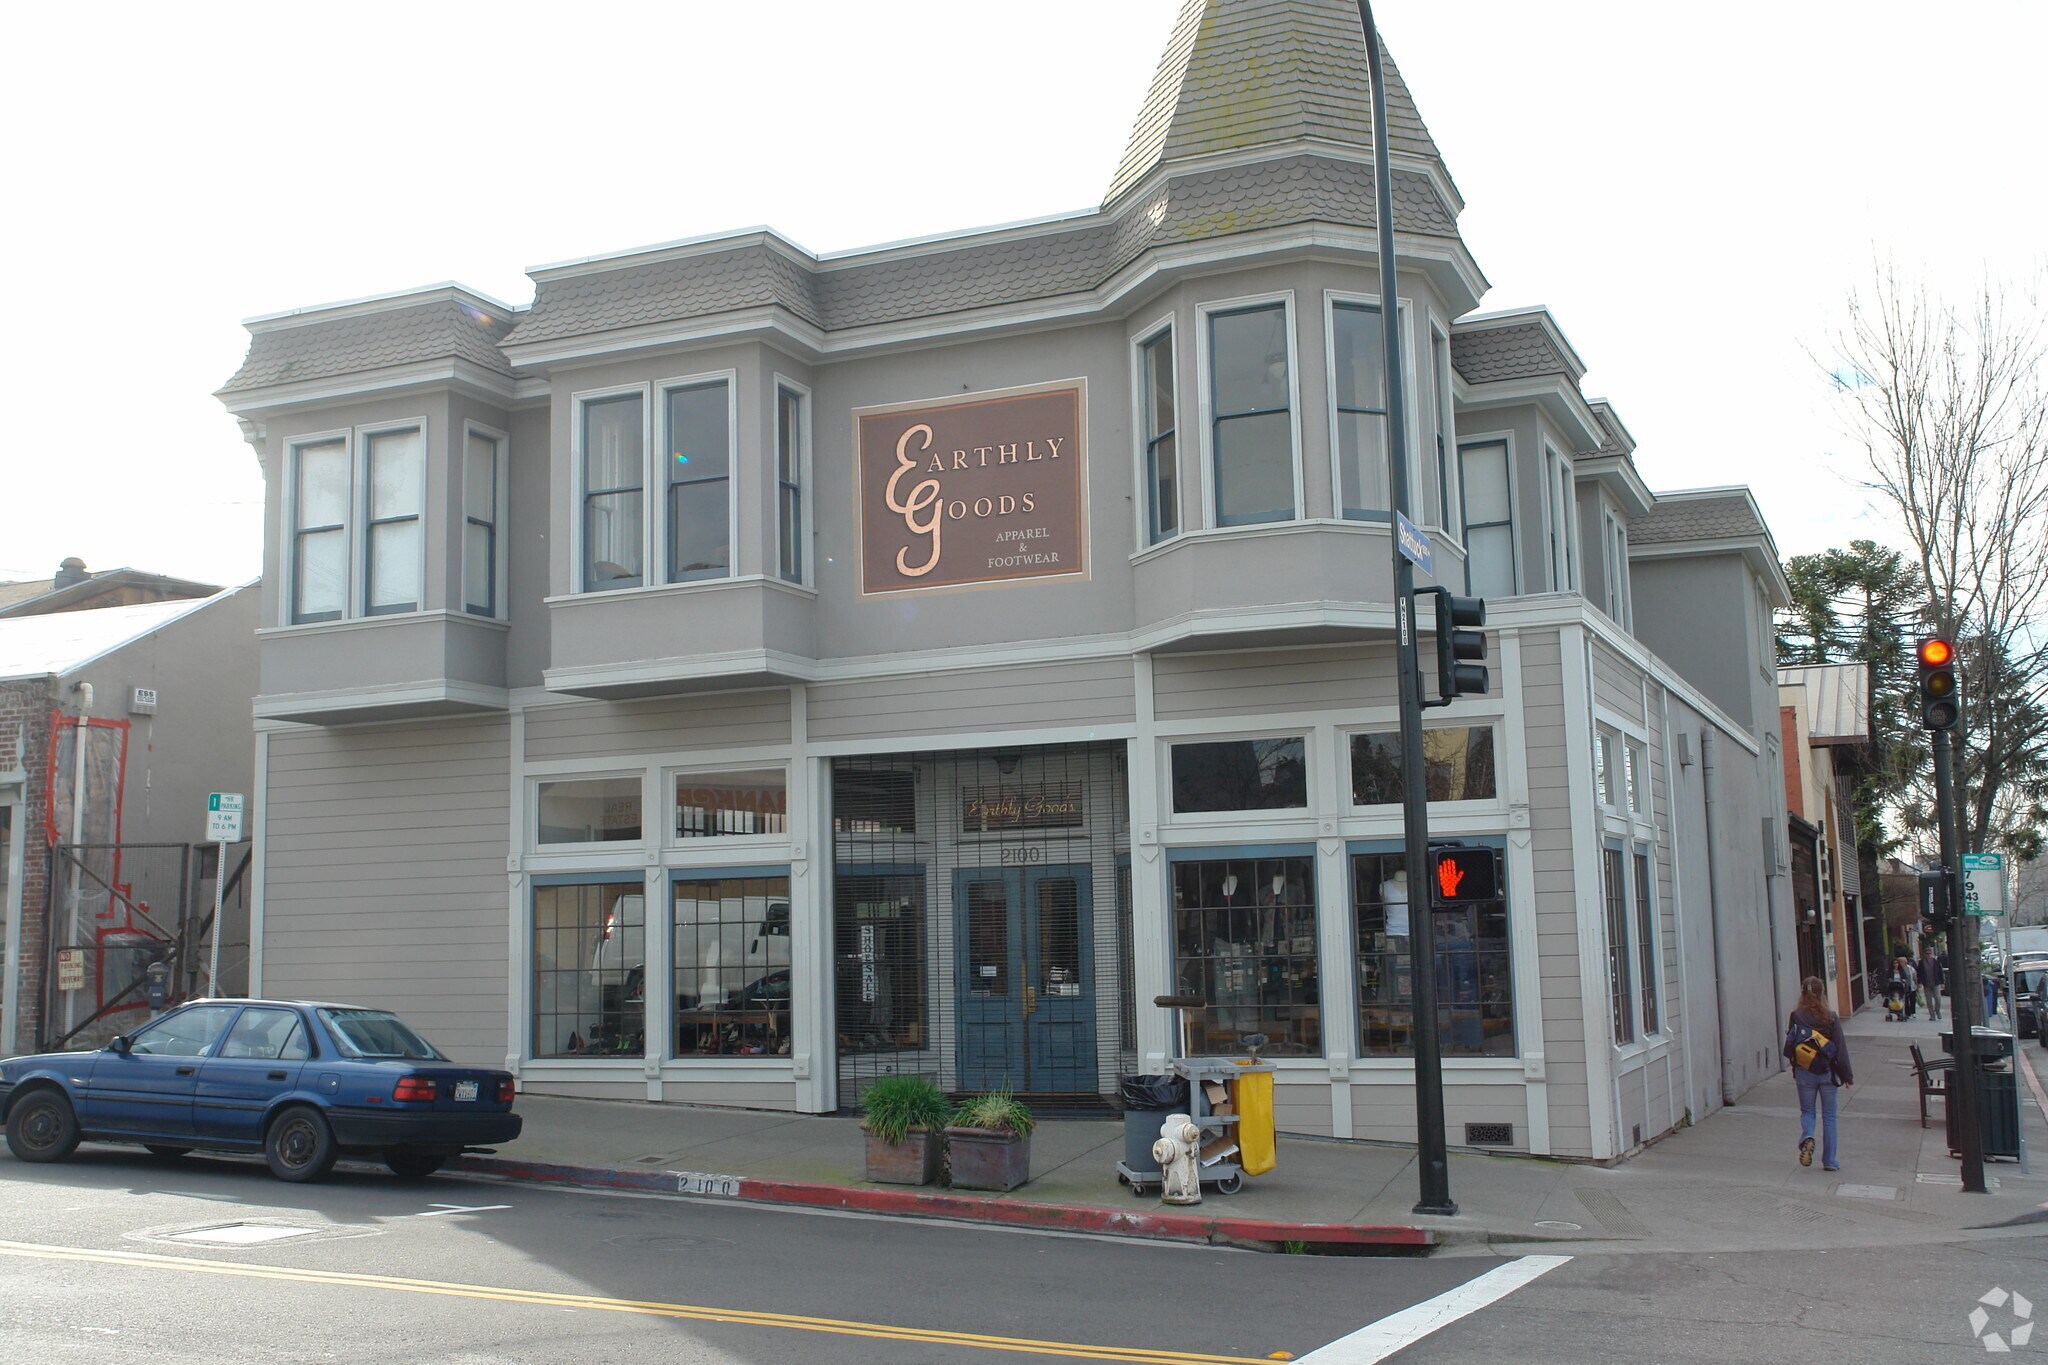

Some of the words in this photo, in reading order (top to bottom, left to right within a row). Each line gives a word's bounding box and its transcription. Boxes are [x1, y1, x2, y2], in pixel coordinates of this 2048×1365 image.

[886, 424, 1064, 514] EARTHLY
[896, 478, 1035, 577] GOODS
[995, 527, 1050, 542] APPAREL
[1019, 542, 1027, 552] &
[1399, 522, 1424, 561] Shattuck
[987, 552, 1060, 568] FOOTWEAR
[213, 797, 217, 807] 1
[221, 802, 241, 810] PARKING
[1001, 847, 1040, 864] 2100
[1965, 870, 1971, 879] 7
[1965, 882, 1974, 891] 9
[1965, 892, 1979, 901] 43
[864, 927, 872, 962] SHOE
[60, 952, 70, 961] NO
[865, 964, 873, 1001] SALE
